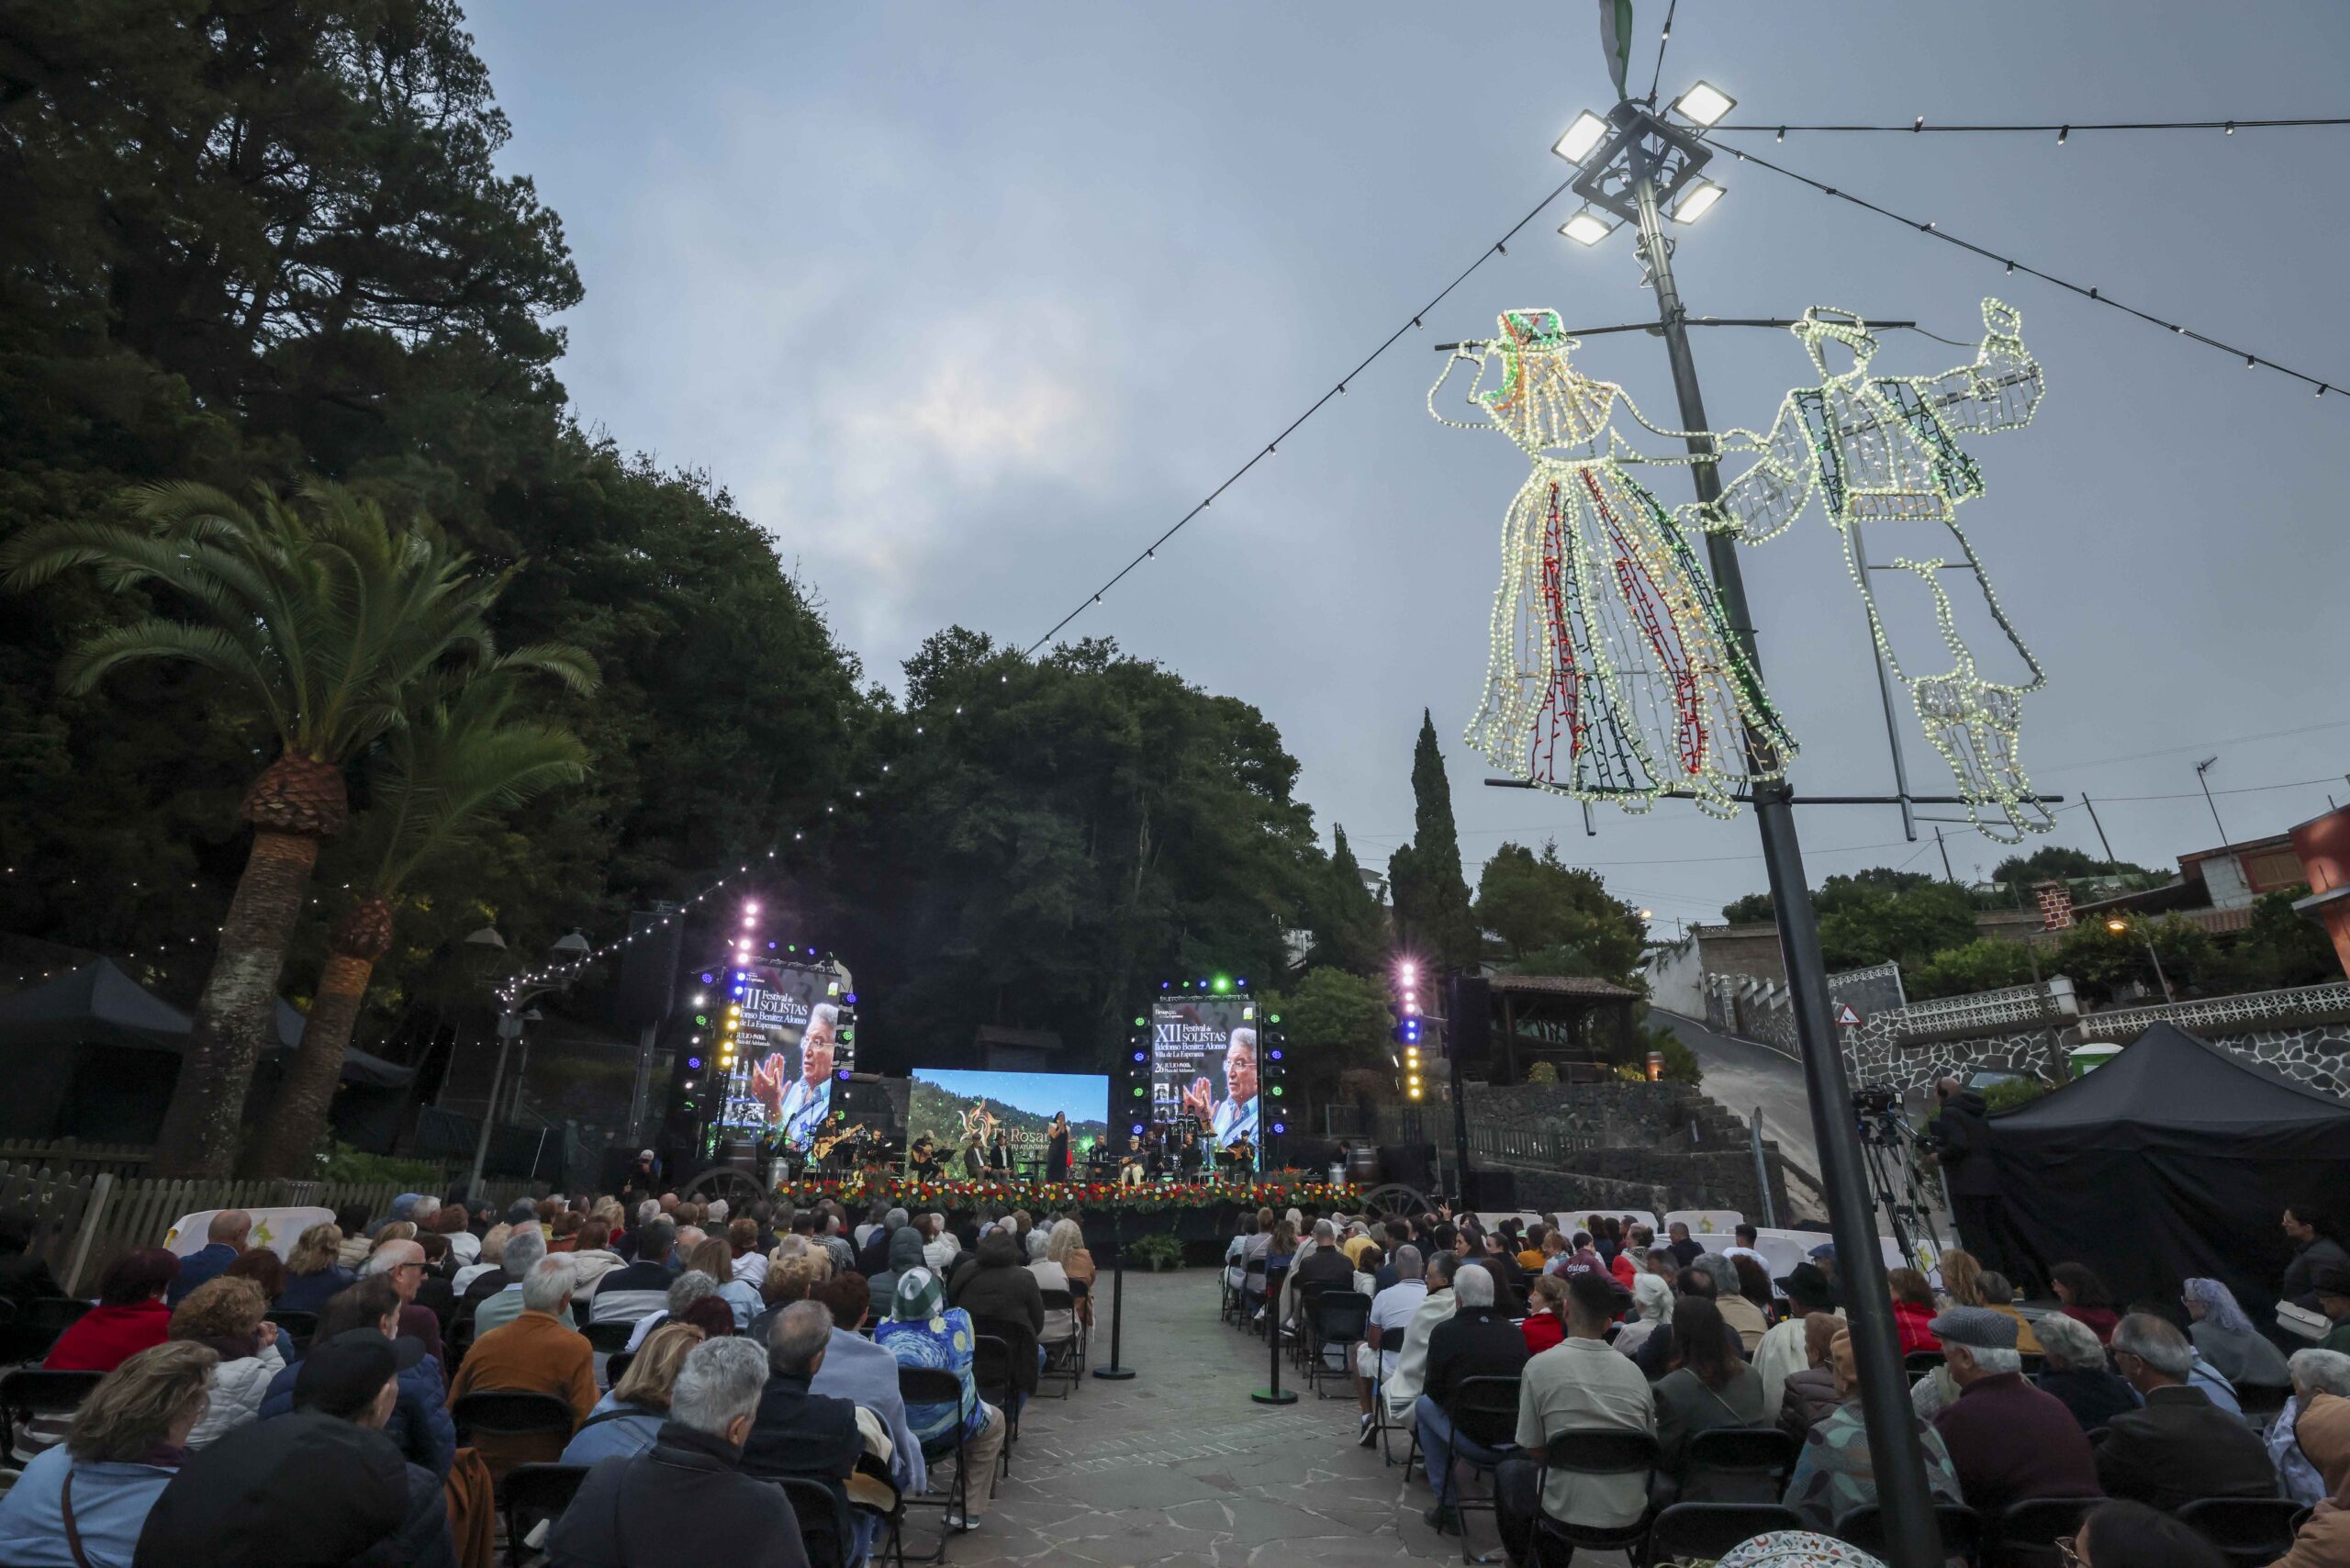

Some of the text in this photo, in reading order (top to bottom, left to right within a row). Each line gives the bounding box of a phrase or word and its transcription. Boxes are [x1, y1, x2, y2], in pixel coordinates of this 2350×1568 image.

[742, 988, 761, 1010] II
[763, 991, 788, 1002] Festival
[761, 1001, 808, 1015] SOLISTAS
[784, 1014, 807, 1025] Alonso
[755, 1021, 782, 1030] Esperanza
[1183, 1024, 1206, 1032] Festival
[1156, 1025, 1181, 1042] XII
[1182, 1033, 1226, 1042] SOLISTAS
[1155, 1042, 1181, 1050] Ildefonso
[1205, 1042, 1226, 1050] Alonso
[1155, 1062, 1164, 1073] 26
[1011, 1128, 1048, 1143] Rosar
